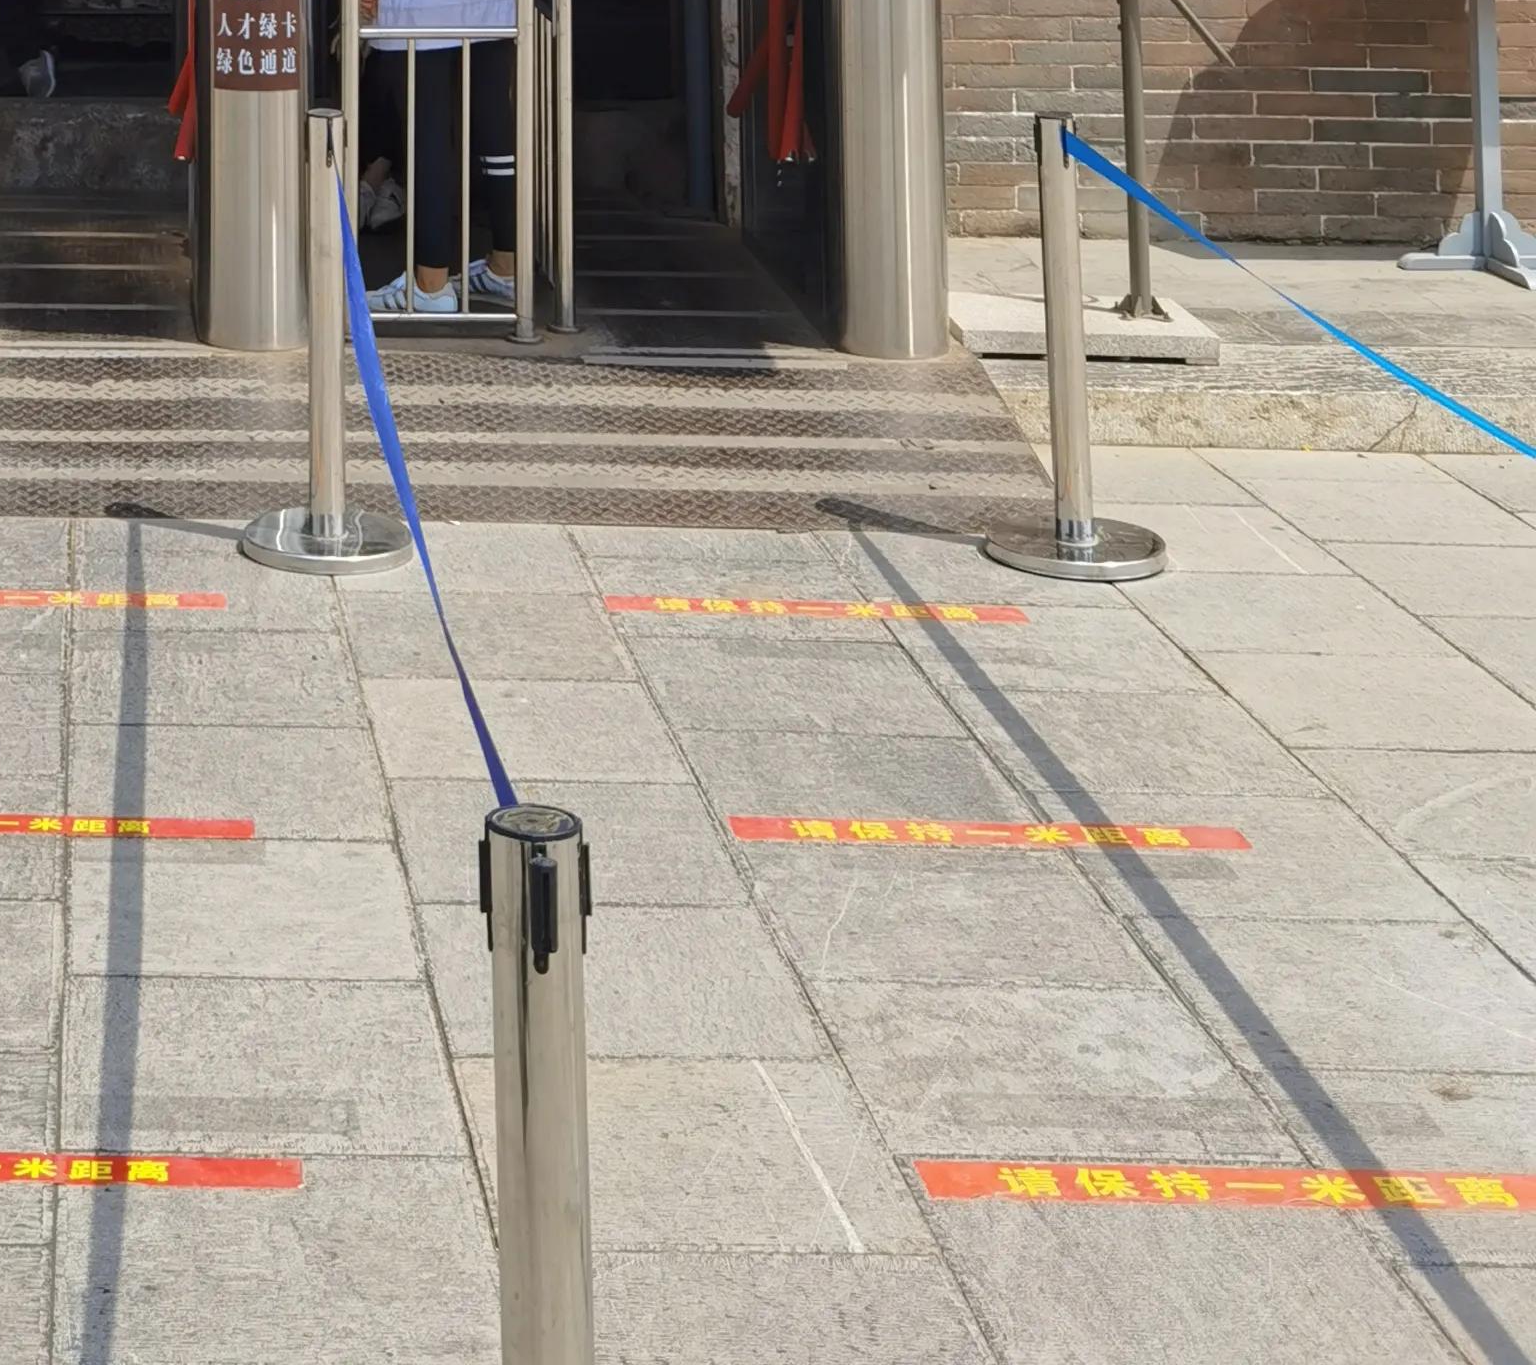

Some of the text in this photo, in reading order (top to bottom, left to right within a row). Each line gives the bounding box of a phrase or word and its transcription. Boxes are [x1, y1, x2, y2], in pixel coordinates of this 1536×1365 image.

[217, 11, 297, 40] 人才绿卡
[216, 47, 297, 75] 绿色通道
[789, 818, 1191, 847] 请保持一米距离
[996, 1165, 1520, 1208] 请保持一米距离
